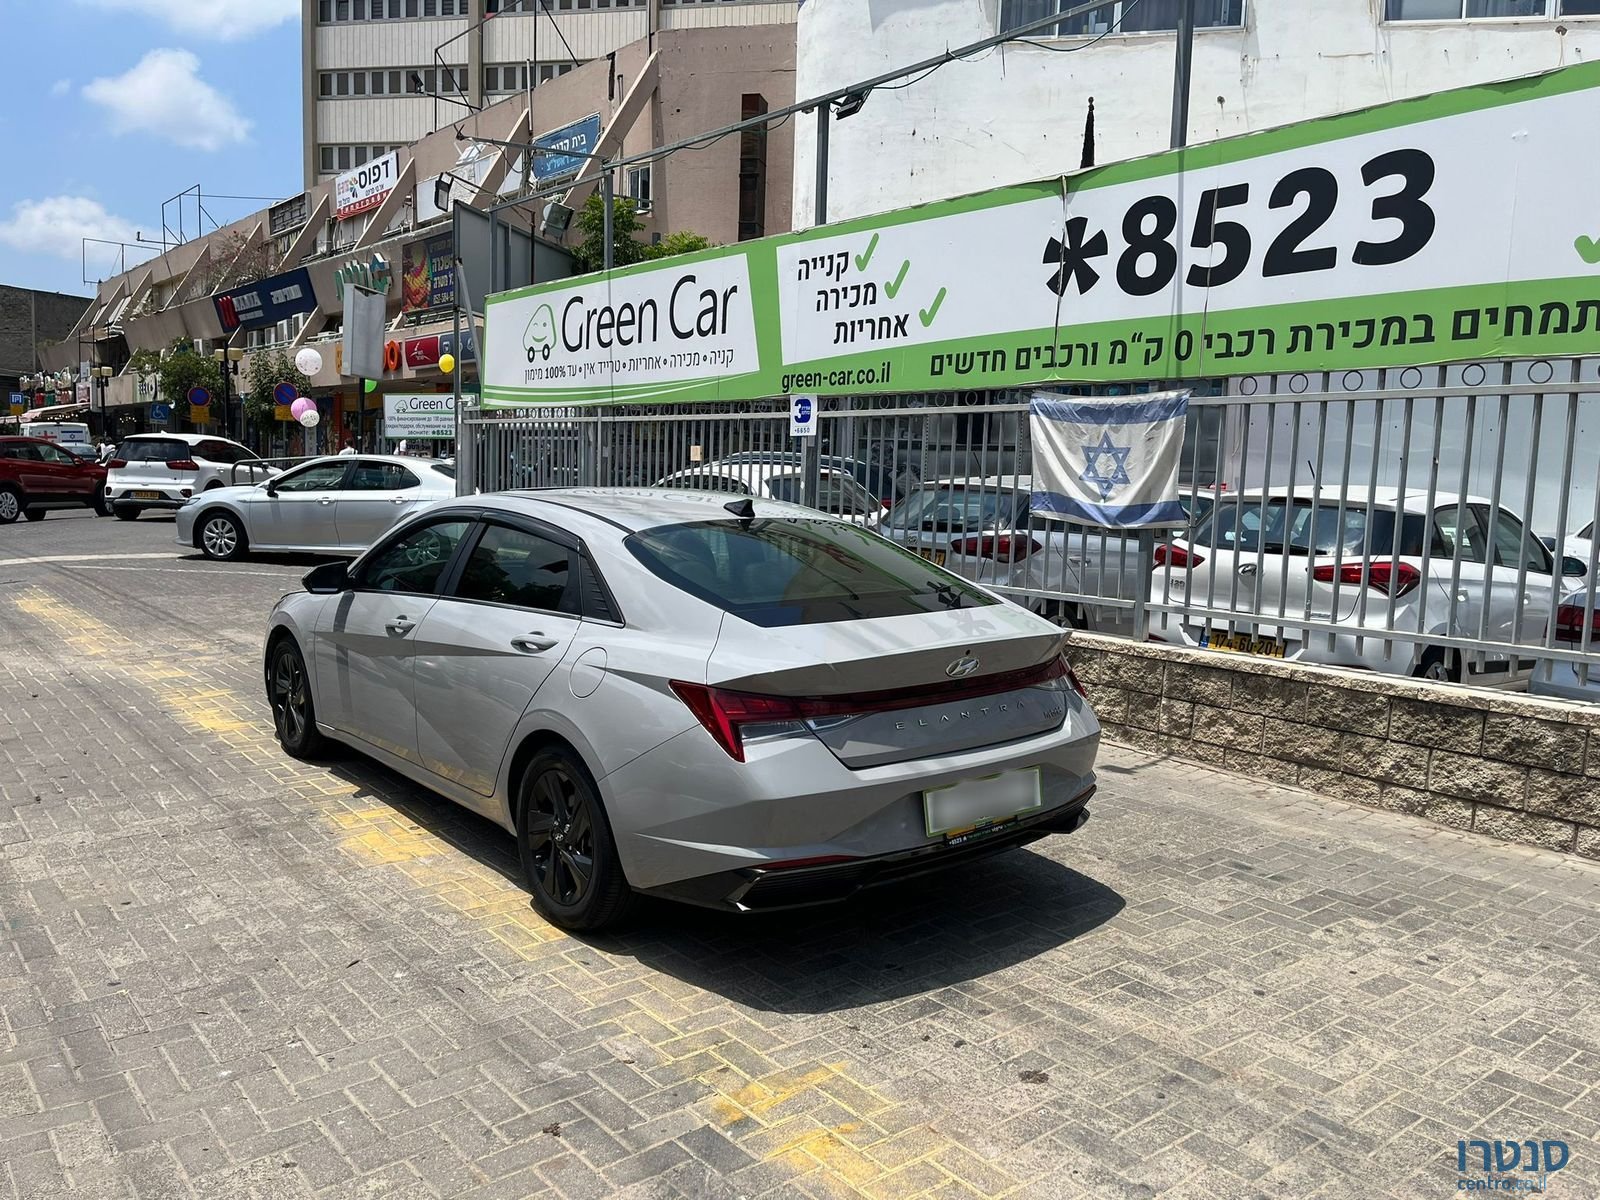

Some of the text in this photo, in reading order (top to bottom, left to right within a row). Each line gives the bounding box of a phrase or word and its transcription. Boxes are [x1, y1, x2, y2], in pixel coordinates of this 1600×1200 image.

[571, 133, 587, 149] בית
[358, 159, 390, 189] דפוס
[797, 250, 850, 282] קנייה
[815, 281, 877, 312] מכירה
[562, 274, 738, 353] Green Car
[833, 313, 910, 345] אחריות
[1203, 328, 1275, 359] רכבי
[1287, 314, 1435, 354] במכירת
[567, 363, 577, 377] עד
[583, 362, 595, 379] אין
[628, 355, 661, 372] אחריות
[669, 352, 700, 369] מכירה
[709, 349, 734, 368] קניה
[930, 347, 1006, 377] חדשים
[1015, 342, 1098, 371] ורכבים
[524, 367, 543, 384] מימון
[545, 365, 566, 380] 100%
[781, 361, 891, 393] green-car.co.il
[409, 397, 443, 410] Green
[895, 700, 1026, 730] ELANTRA
